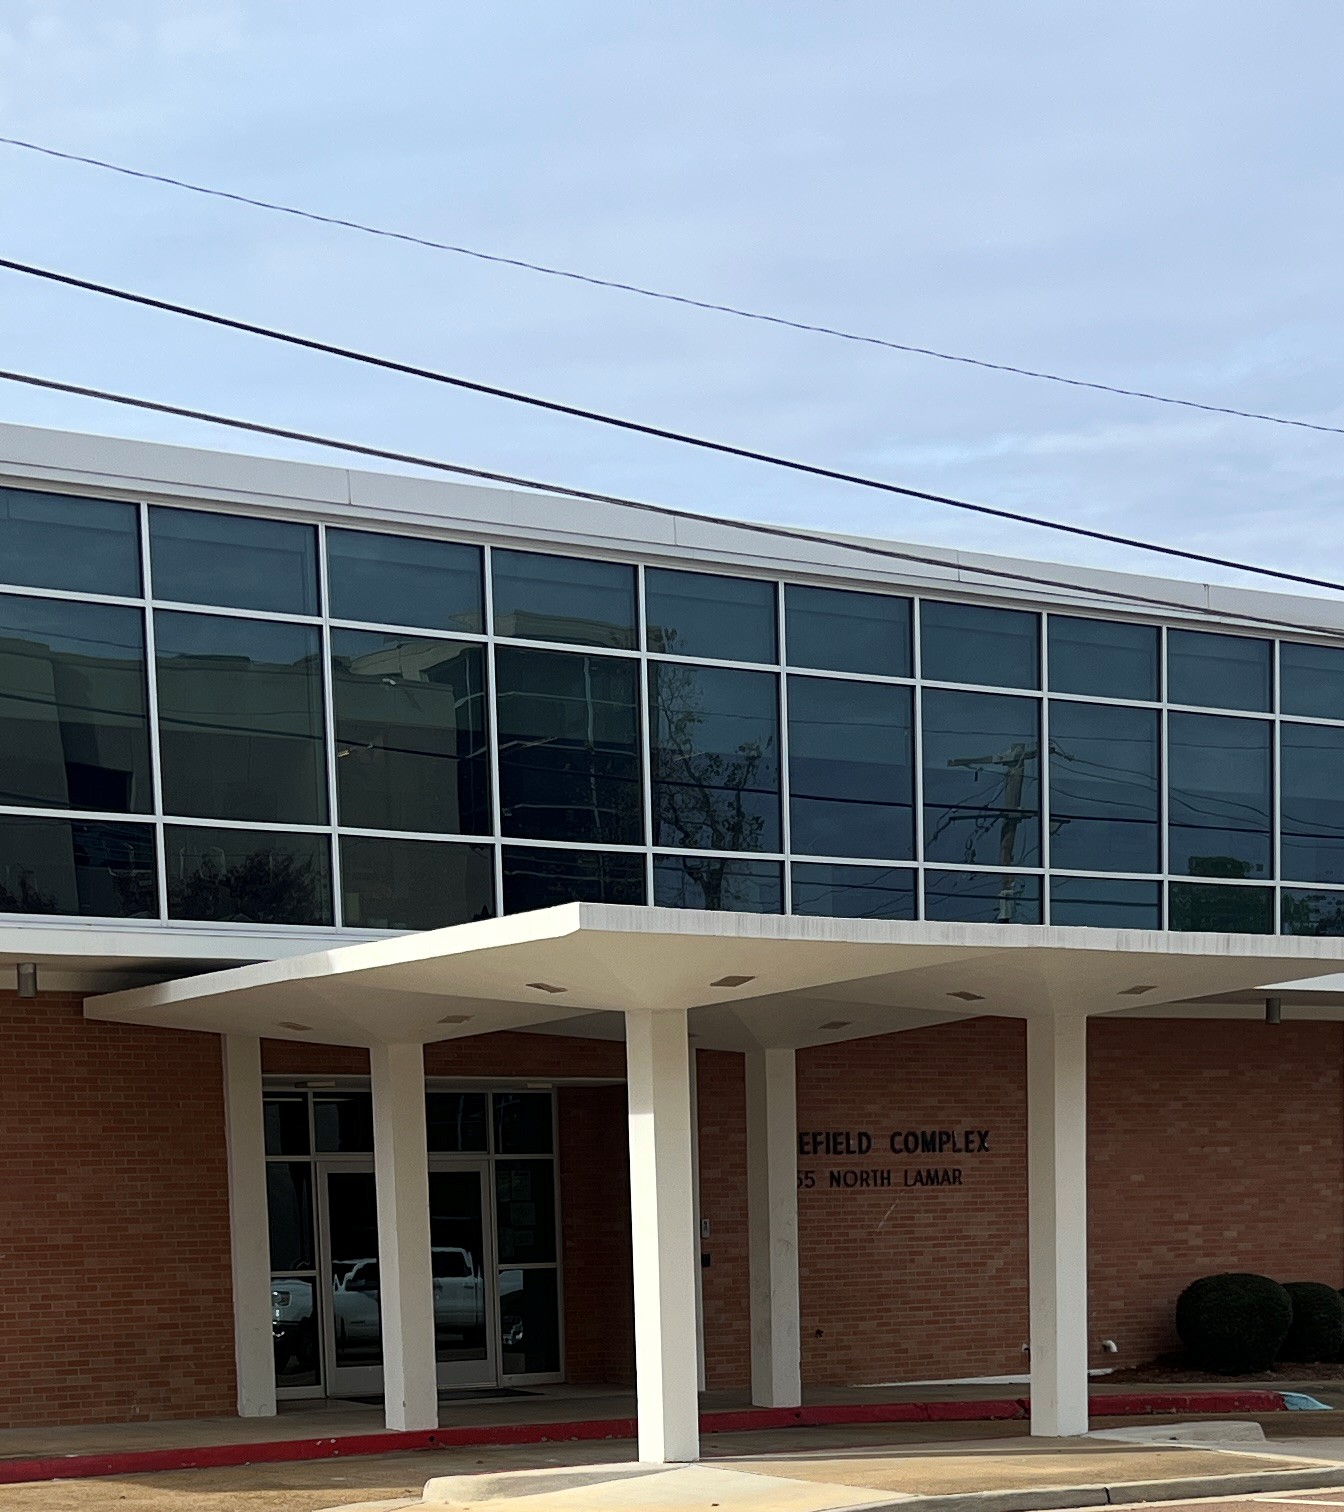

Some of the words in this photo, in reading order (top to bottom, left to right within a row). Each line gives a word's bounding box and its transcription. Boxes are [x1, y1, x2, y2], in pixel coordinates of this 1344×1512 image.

[798, 1131, 872, 1155] EFIELD
[890, 1130, 990, 1154] COMPLEX
[829, 1169, 891, 1189] NORTH
[904, 1168, 963, 1187] LAMAR
